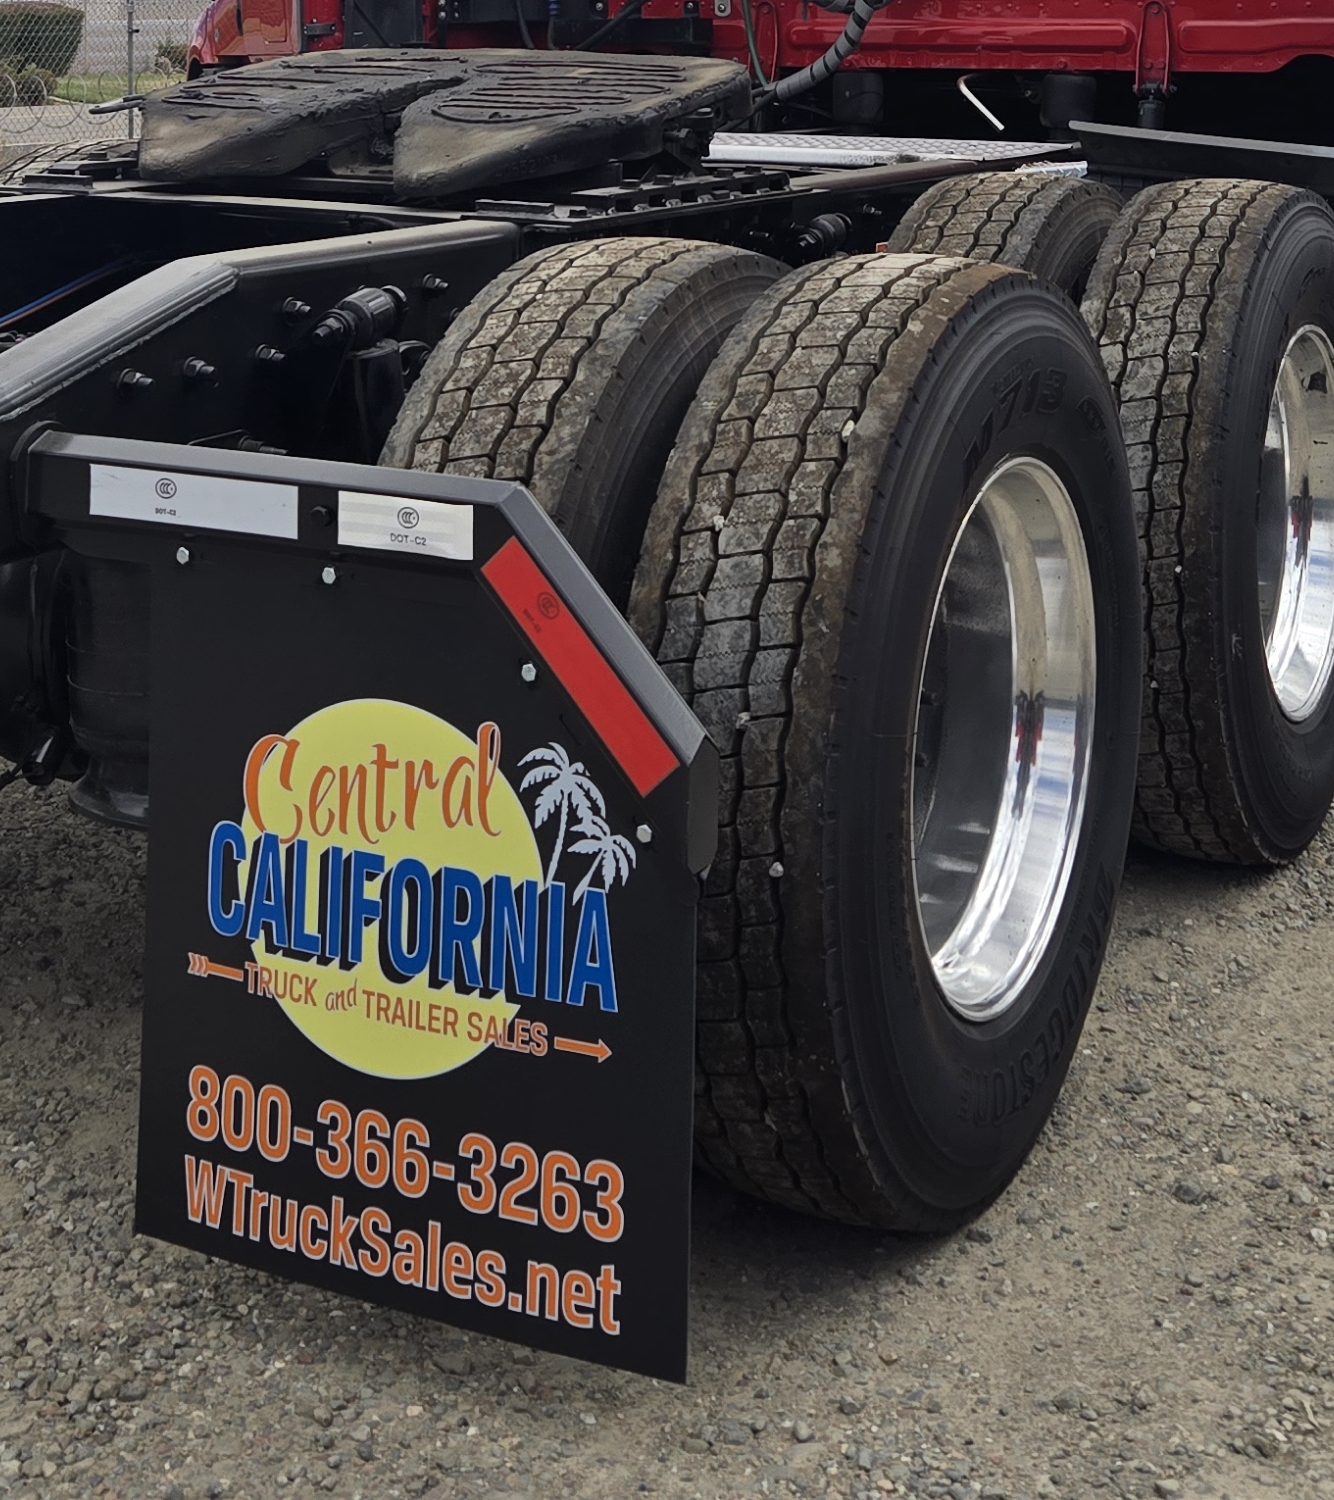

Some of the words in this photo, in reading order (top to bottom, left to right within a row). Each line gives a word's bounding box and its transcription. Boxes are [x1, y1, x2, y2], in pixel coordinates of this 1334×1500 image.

[155, 507, 177, 516] DOT-C2
[390, 532, 427, 546] DOT-C2
[244, 721, 502, 844] Central
[207, 821, 618, 1012] CALIFORNIA
[244, 962, 318, 1007] TRUCK
[325, 978, 357, 1011] and
[362, 989, 458, 1037] TRAILER
[467, 1012, 548, 1057] SALES
[186, 1065, 625, 1242] 800-366-3263
[184, 1154, 622, 1336] WTruckSales.net
